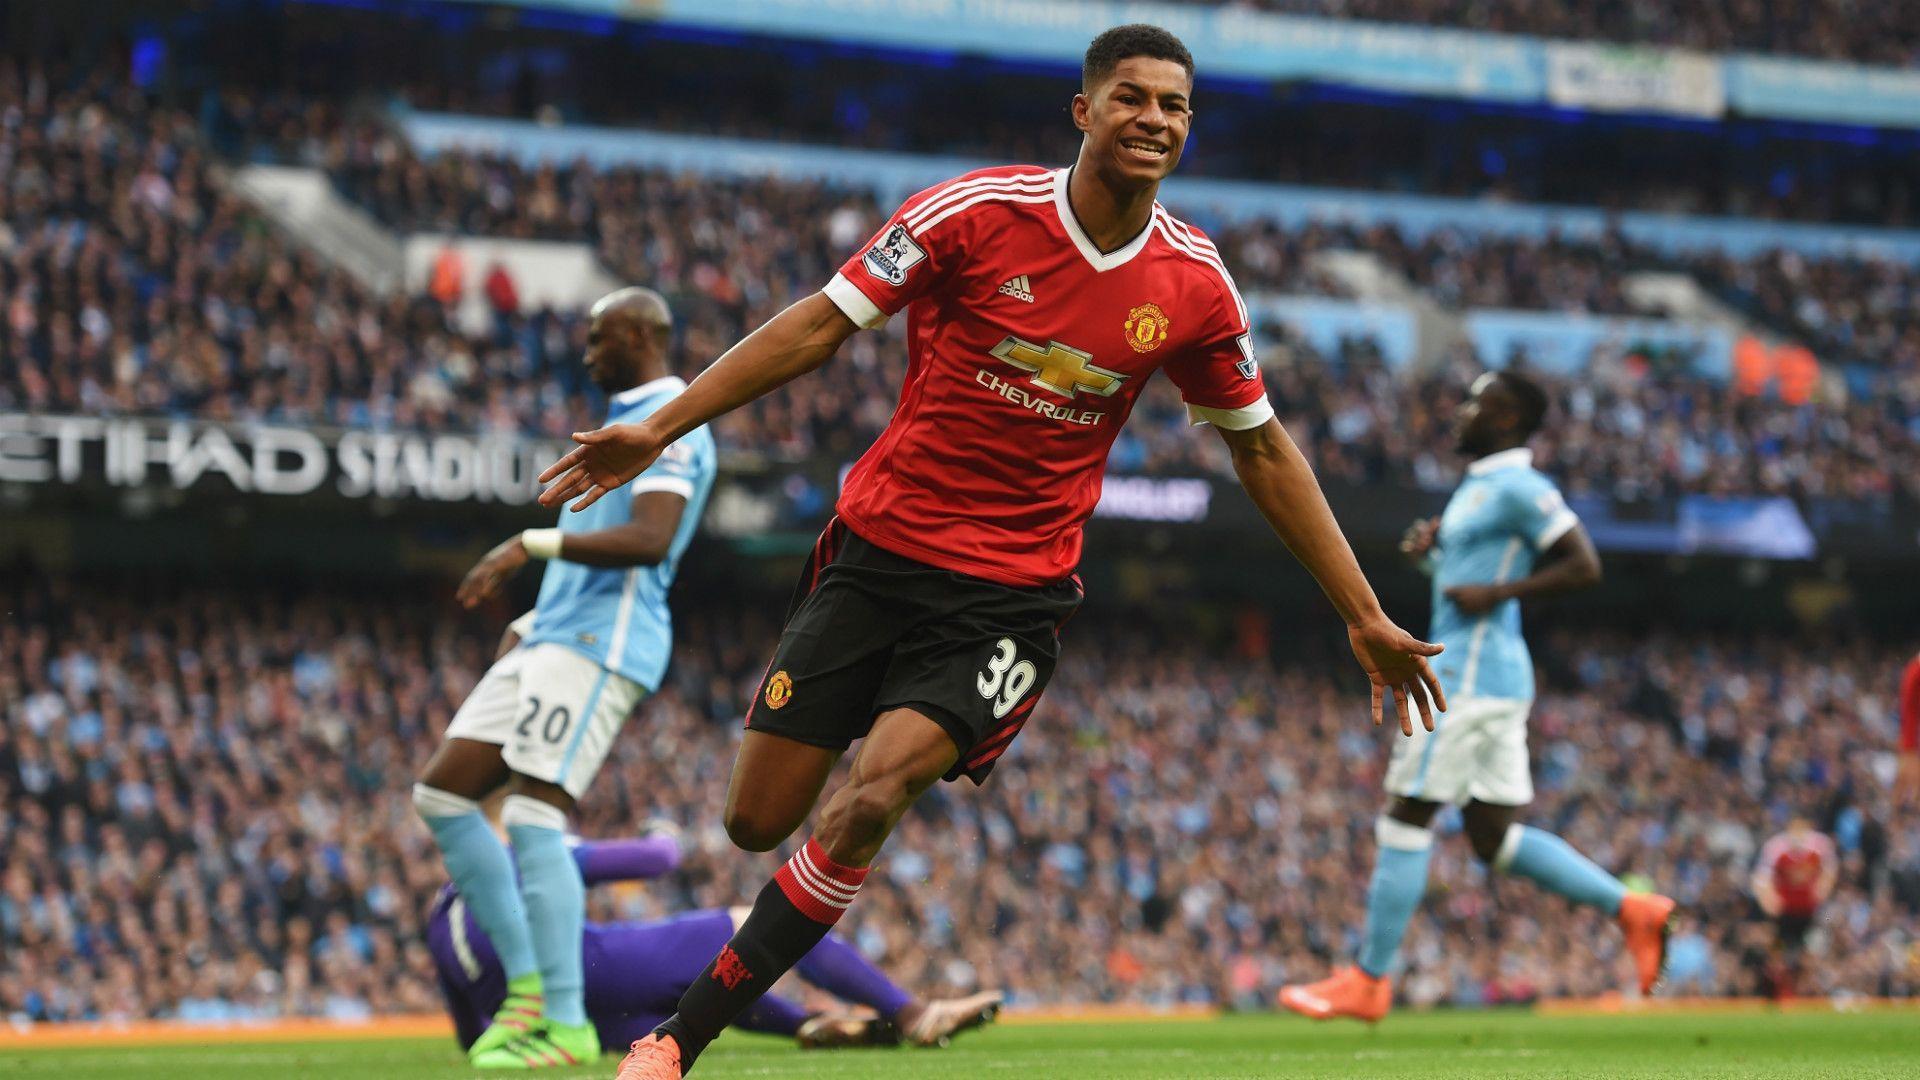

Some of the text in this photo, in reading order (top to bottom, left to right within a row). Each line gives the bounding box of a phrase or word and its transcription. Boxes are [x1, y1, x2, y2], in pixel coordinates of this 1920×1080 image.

[998, 285, 1034, 303] adidas
[1131, 306, 1165, 328] MANCHESTER
[975, 369, 1105, 426] CHEVROLET
[0, 414, 329, 495] ETIHAD
[976, 636, 1037, 719] 39
[516, 696, 570, 744] 20
